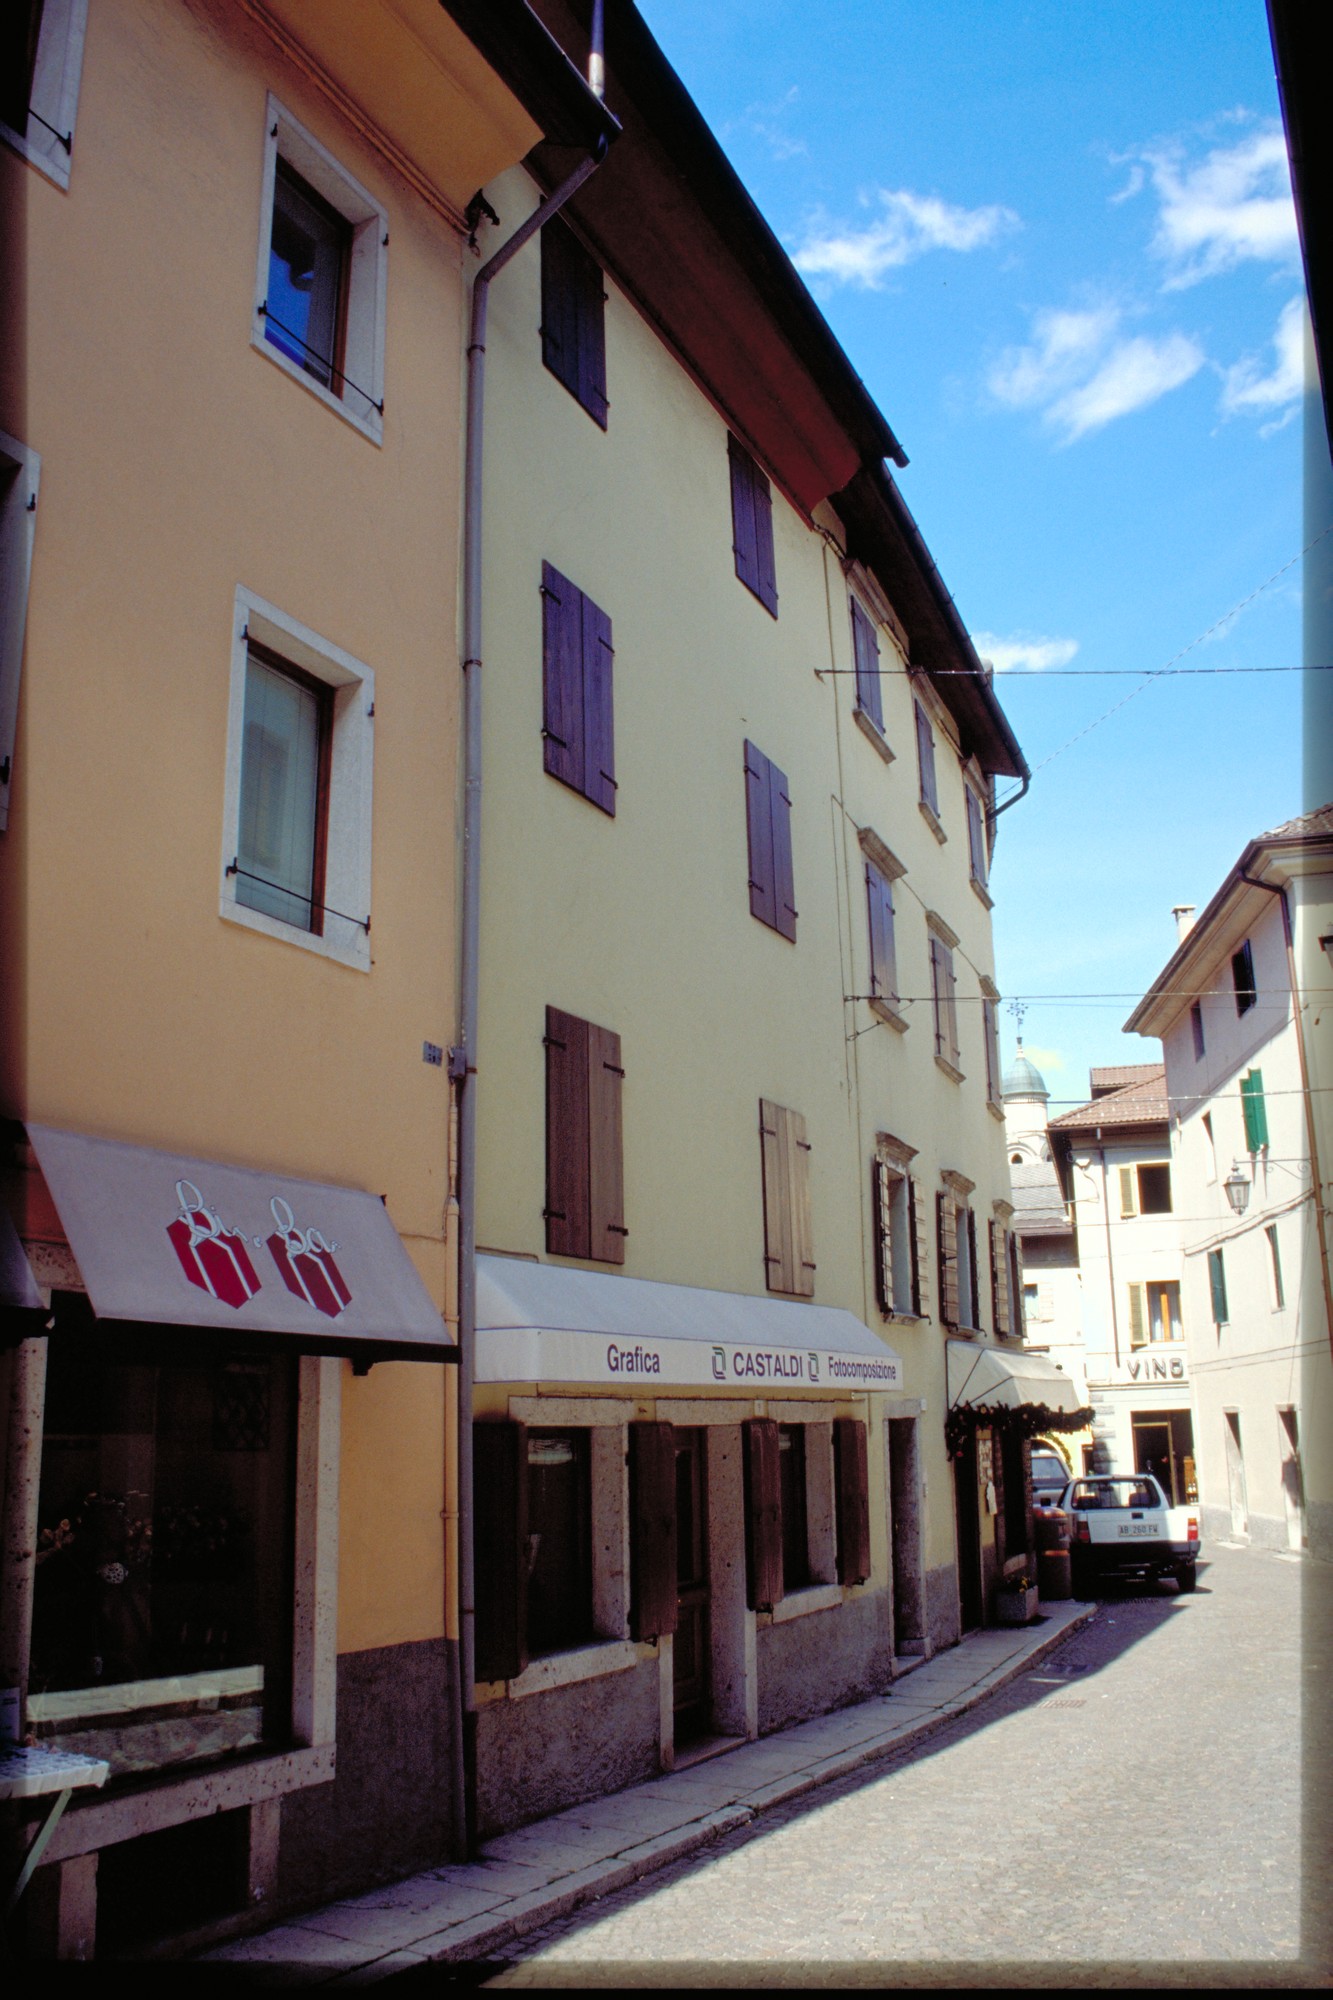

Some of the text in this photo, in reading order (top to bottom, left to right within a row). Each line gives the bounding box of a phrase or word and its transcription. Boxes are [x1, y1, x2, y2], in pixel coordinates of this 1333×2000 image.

[606, 1343, 897, 1382] Grafica CASTALDI Fotocomposizione
[1126, 1357, 1184, 1380] VINO
